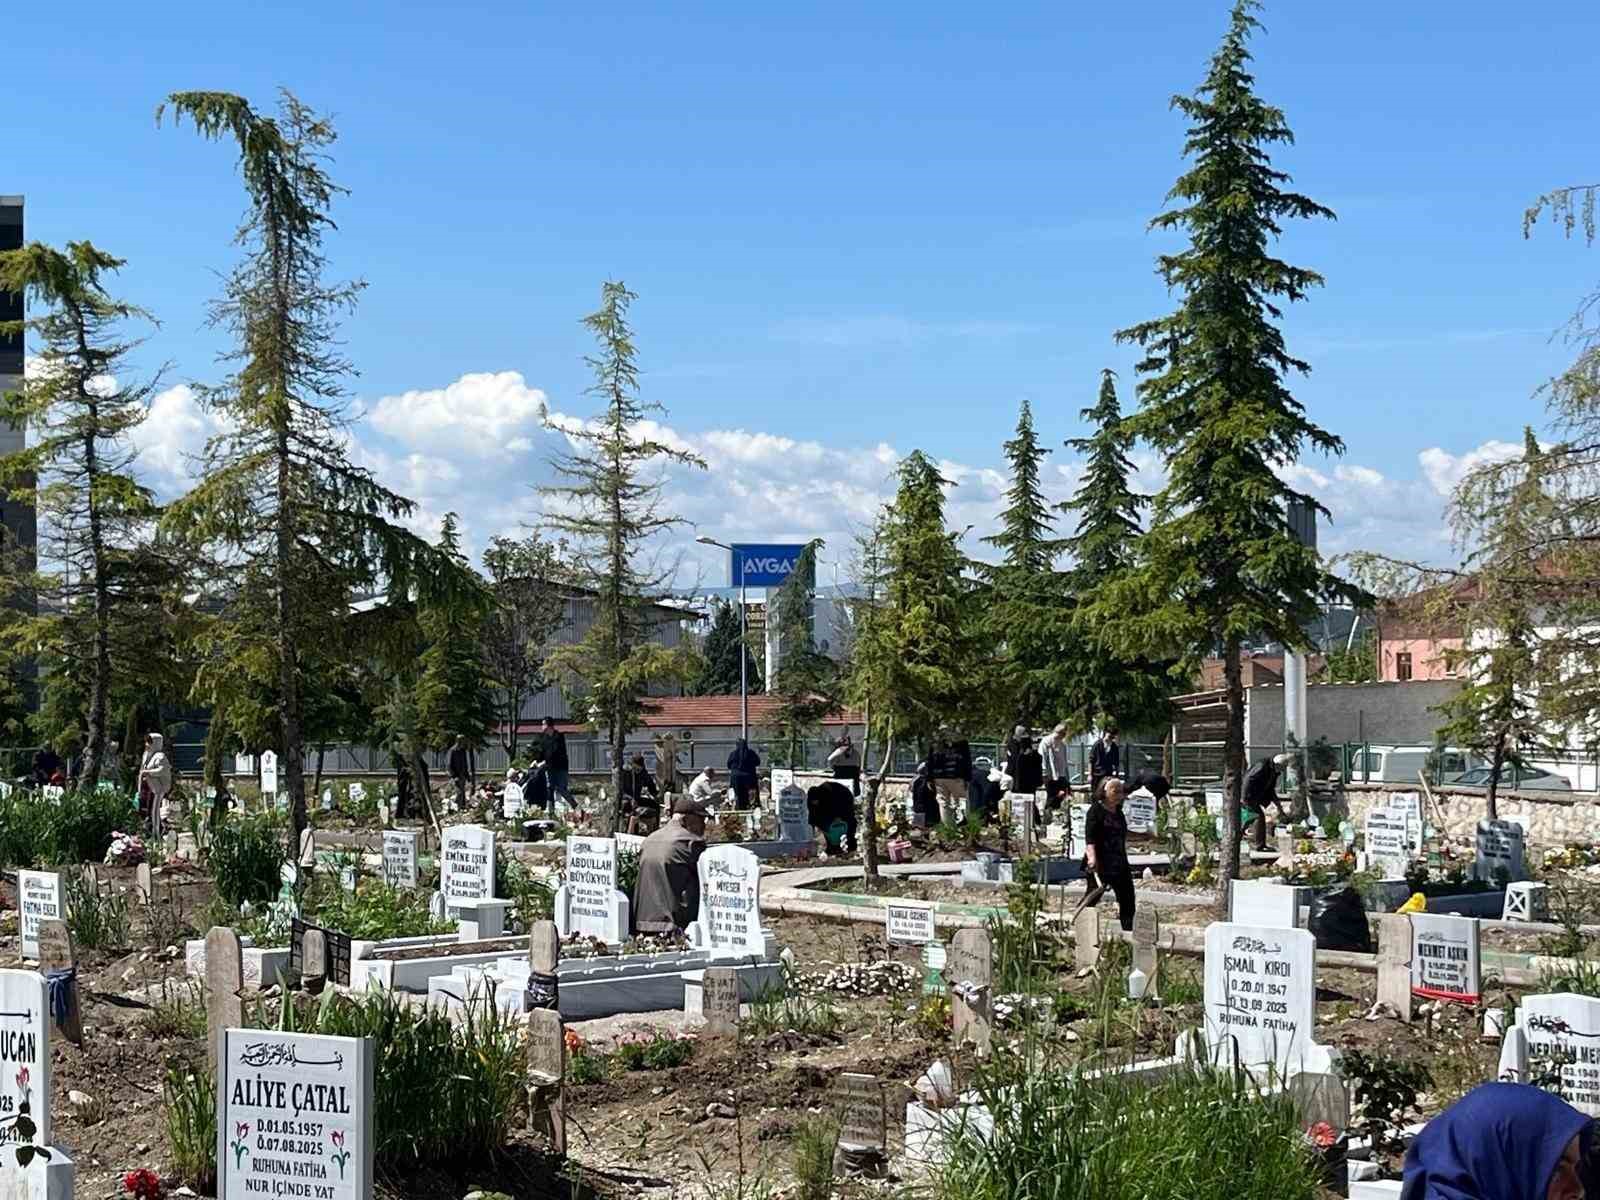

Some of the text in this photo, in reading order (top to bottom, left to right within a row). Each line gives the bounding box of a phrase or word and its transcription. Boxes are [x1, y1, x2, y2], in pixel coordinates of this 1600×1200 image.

[743, 556, 799, 574] AYGA
[445, 850, 469, 863] EMİNE
[571, 857, 612, 871] ABDULLAH
[569, 871, 612, 885] BÜYÜKYOL
[1418, 943, 1446, 959] MEHMET
[1224, 953, 1257, 974] İSMAİL
[1219, 1012, 1296, 1032] RUHUNA FATİHA
[231, 1073, 350, 1118] ALİYE ÇATAL
[257, 1118, 323, 1137] D.01.05.1957
[257, 1135, 324, 1155] Ö.07.08.2025
[252, 1157, 327, 1179] RUHUNA FATİHA
[245, 1178, 335, 1200] NUR İÇİNDE YAT
